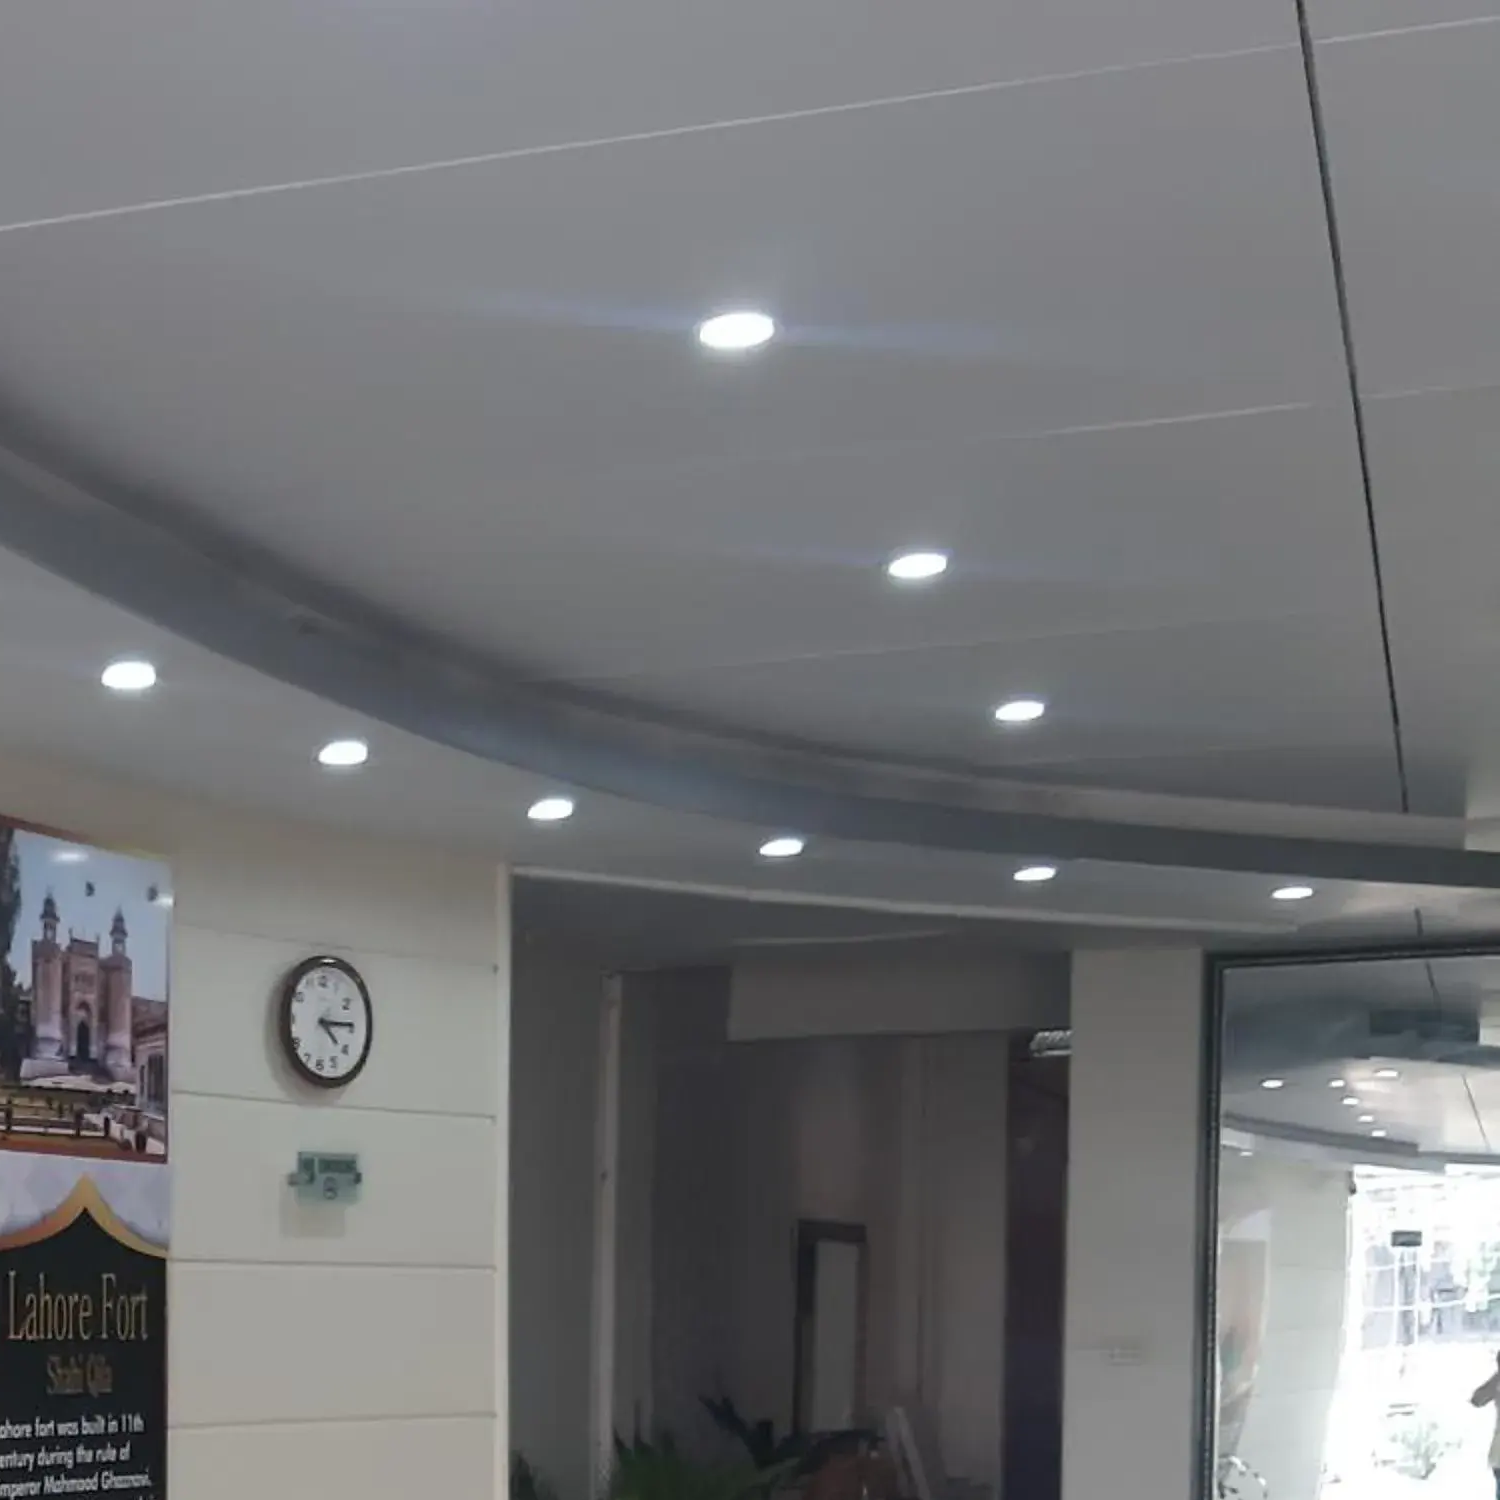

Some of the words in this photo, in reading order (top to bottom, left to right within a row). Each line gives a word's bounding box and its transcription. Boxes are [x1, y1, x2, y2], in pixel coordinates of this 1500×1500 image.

[7, 1270, 93, 1341] Lahore
[101, 1272, 148, 1341] Fort
[35, 1415, 55, 1437] fort
[57, 1421, 79, 1436] was
[81, 1414, 104, 1434] built
[108, 1413, 118, 1433] in
[37, 1445, 74, 1469] during
[76, 1444, 93, 1463] the
[96, 1441, 117, 1462] rule
[119, 1440, 131, 1461] of
